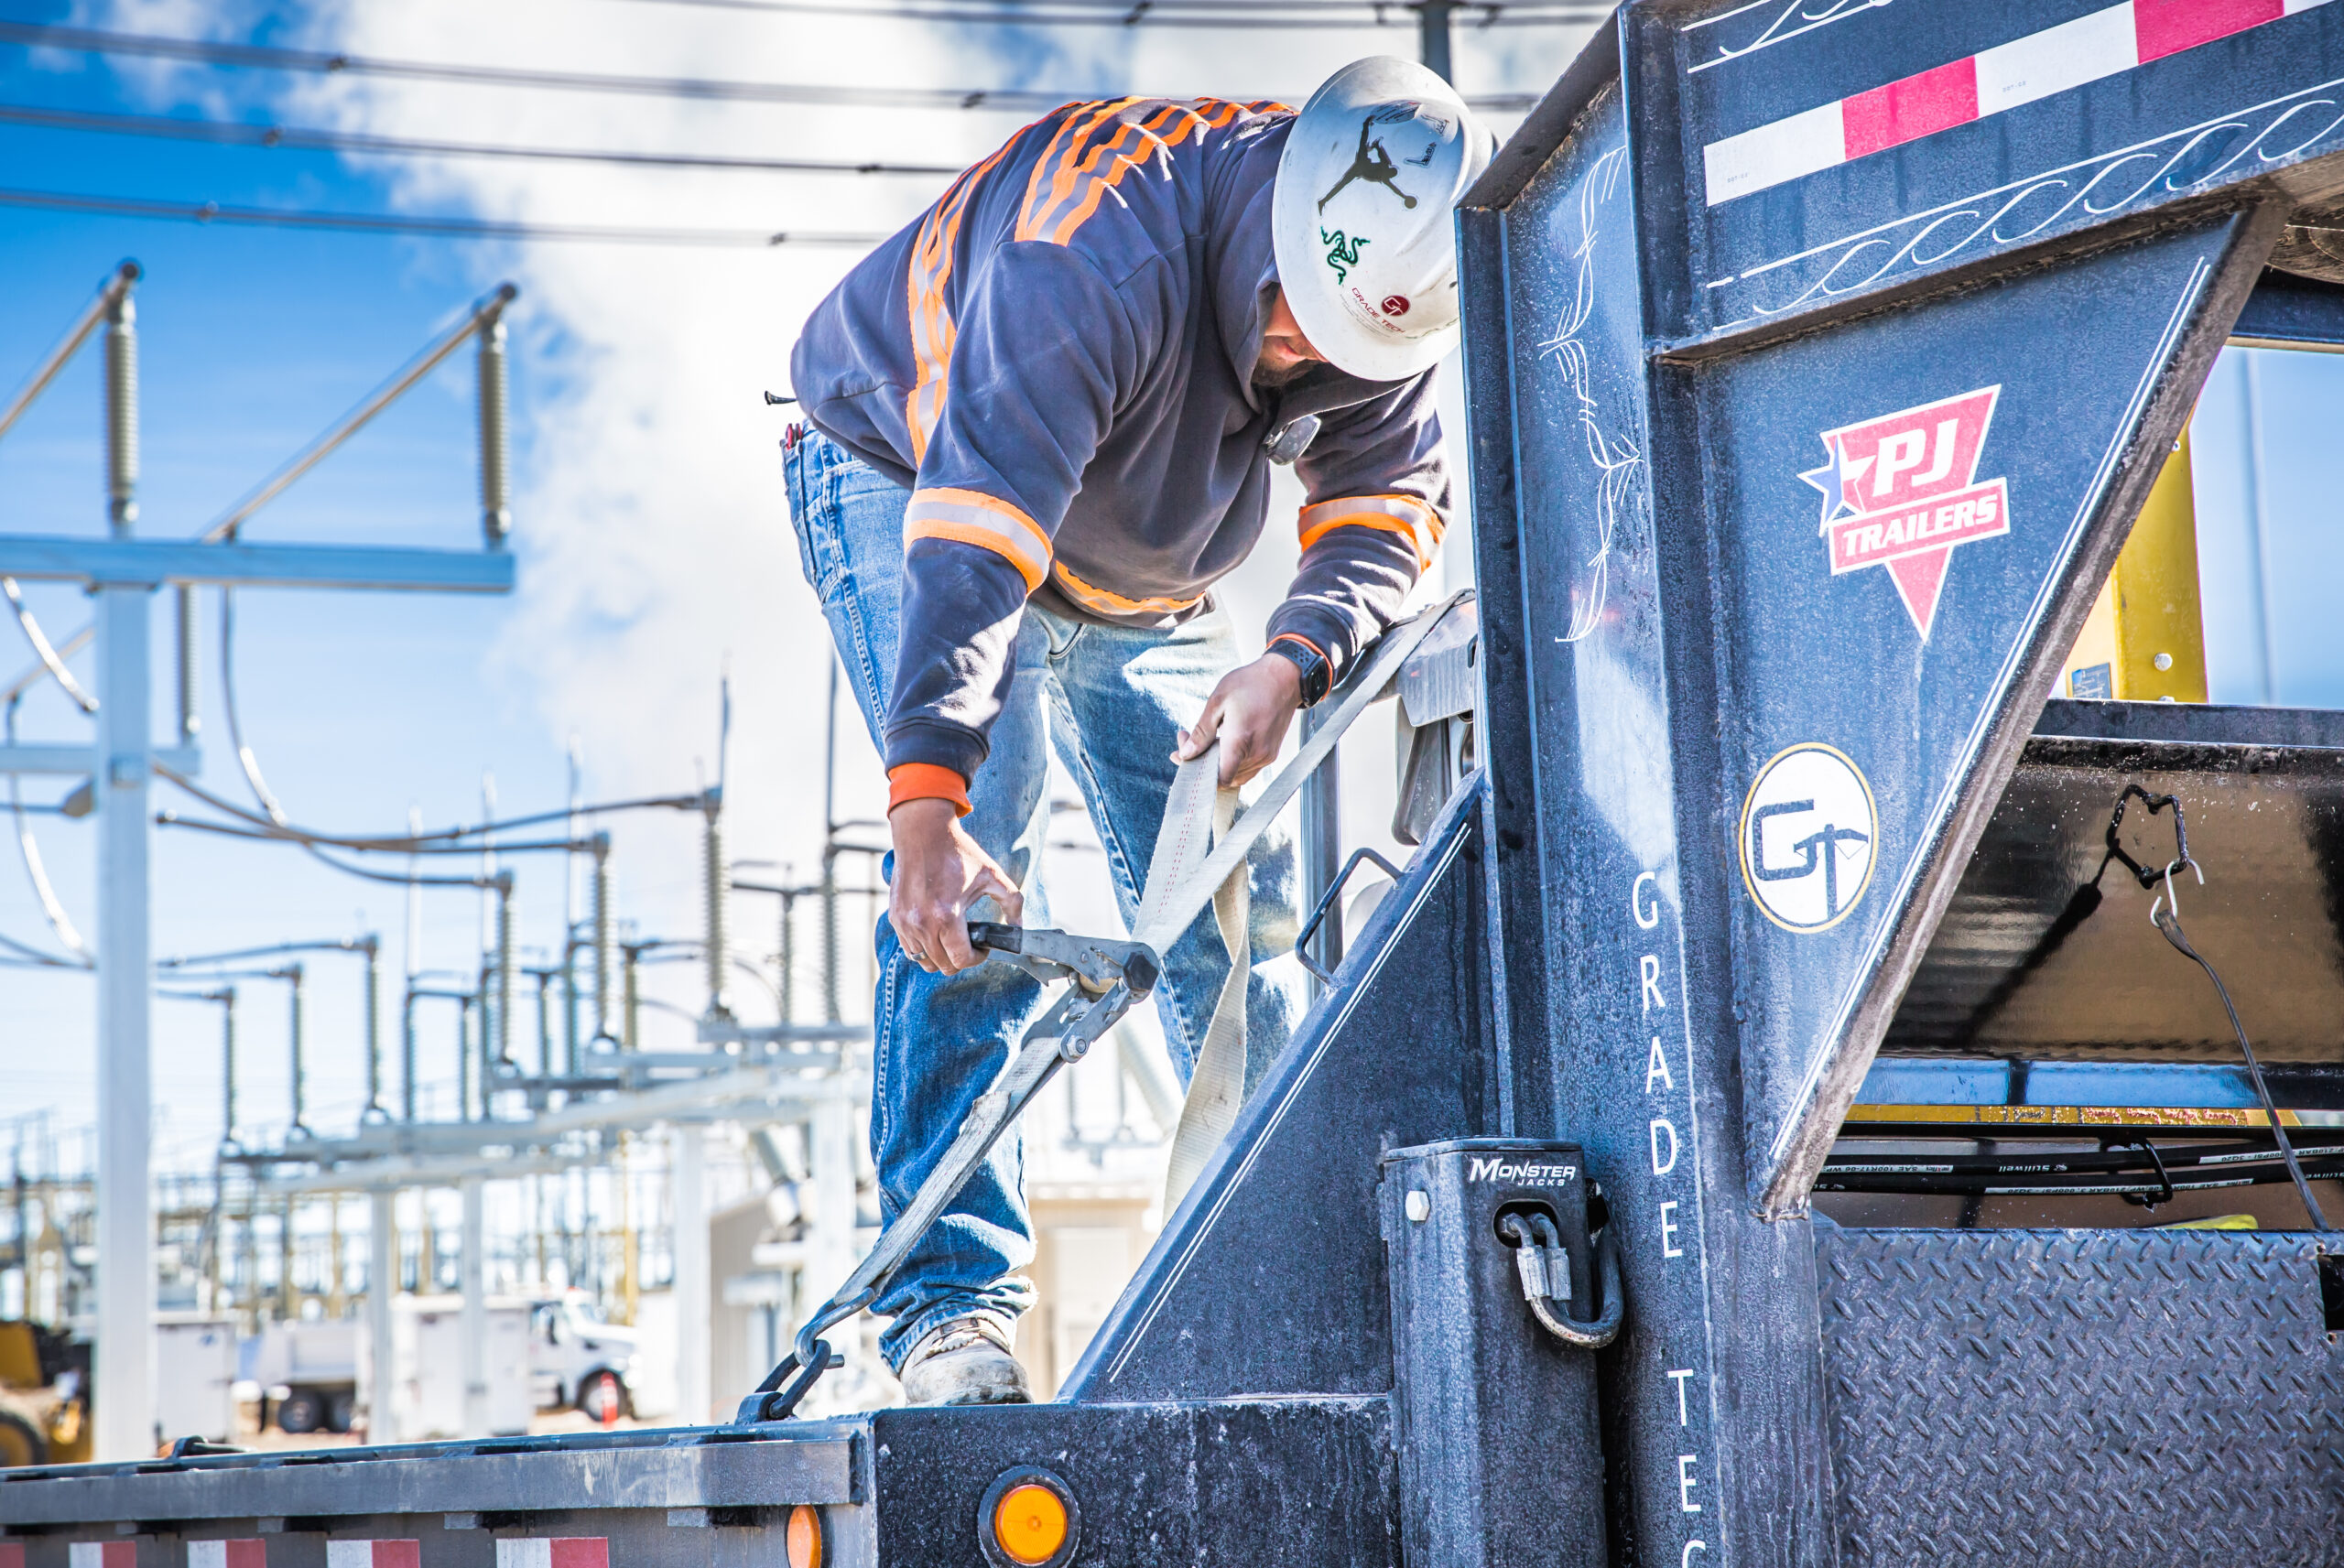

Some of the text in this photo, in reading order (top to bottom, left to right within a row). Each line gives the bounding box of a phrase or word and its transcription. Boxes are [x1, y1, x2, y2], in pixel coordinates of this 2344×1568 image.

[1351, 287, 1381, 319] GRADE
[1382, 319, 1406, 333] TECH
[1872, 418, 1959, 497] PJ
[1842, 494, 1998, 557] TRAILERS
[1632, 871, 1684, 1259] GRADE
[1517, 1178, 1566, 1186] JACKS
